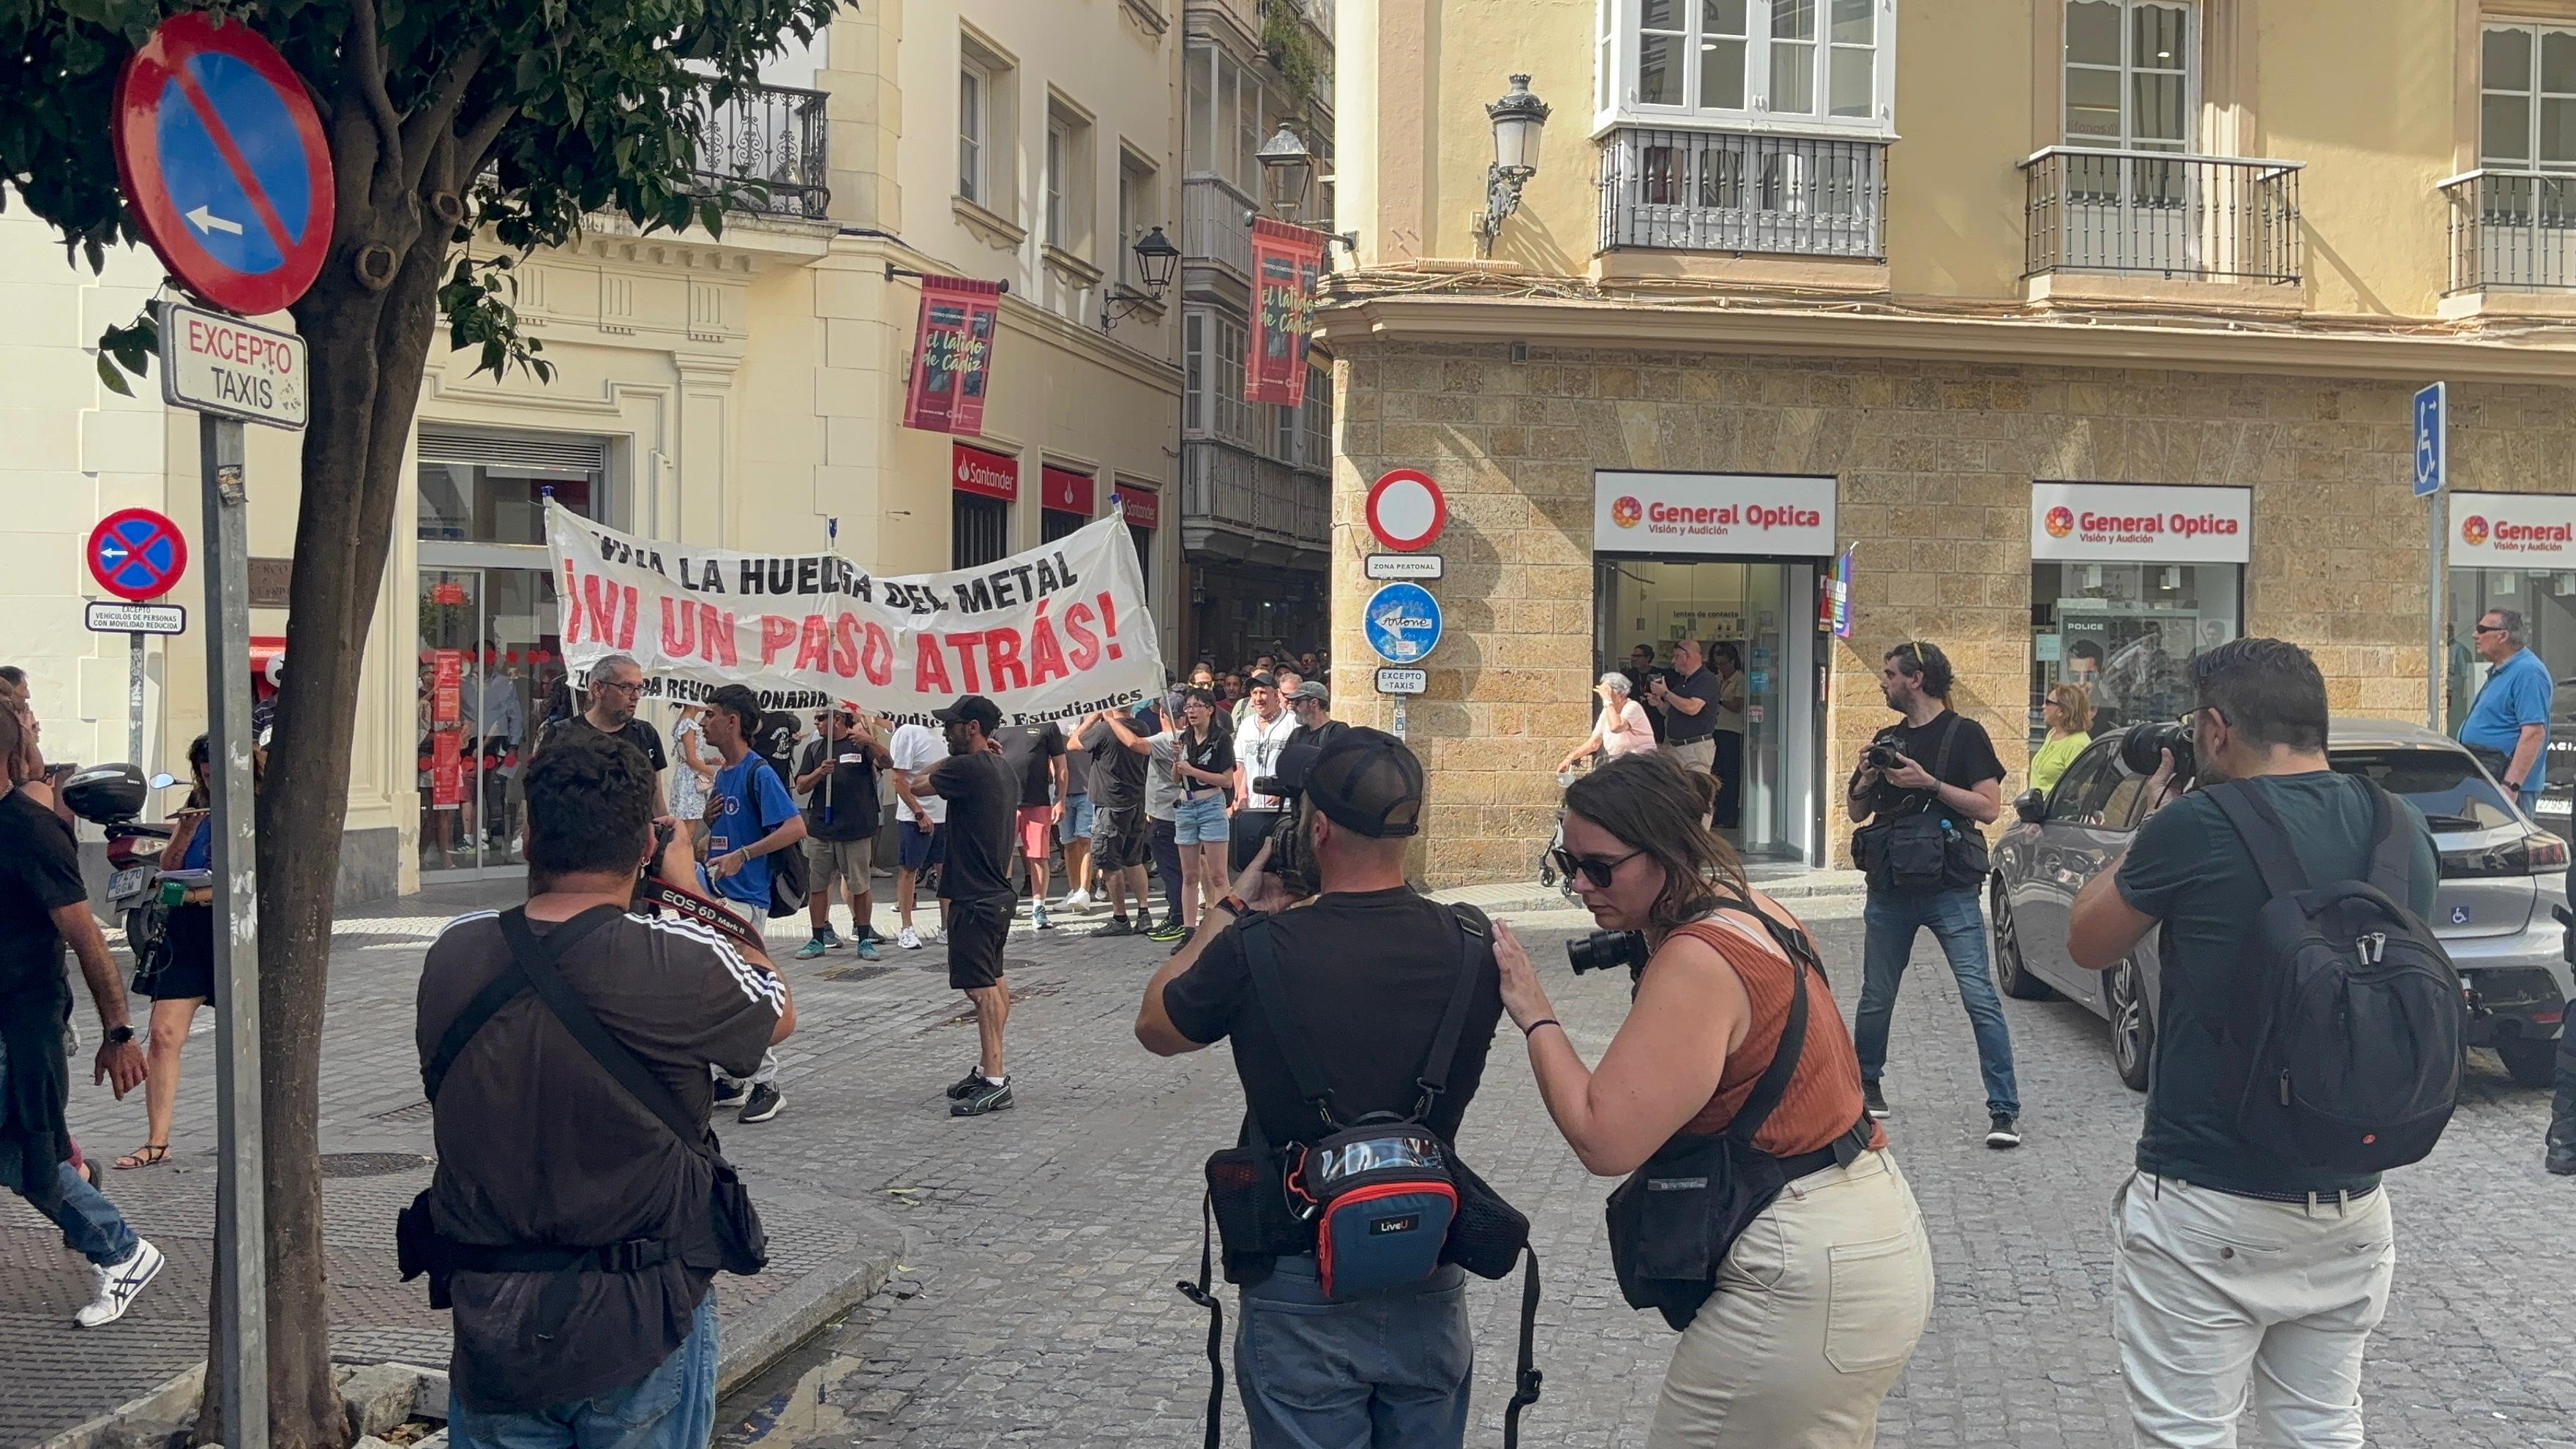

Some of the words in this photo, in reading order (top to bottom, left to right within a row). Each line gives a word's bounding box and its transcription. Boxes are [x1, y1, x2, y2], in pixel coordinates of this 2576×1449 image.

[1262, 285, 1274, 307] El
[1278, 284, 1316, 313] latido
[1259, 307, 1276, 327] de
[1279, 313, 1313, 337] Cádiz
[189, 320, 292, 374] EXCEPTO
[926, 330, 940, 348] El
[943, 329, 985, 356] latido
[921, 350, 940, 367] de
[942, 353, 983, 375] Cádiz
[211, 367, 272, 409] TAXIS
[970, 462, 1014, 492] Santander
[1126, 499, 1156, 521] Santander
[1649, 502, 1740, 525] General
[1745, 504, 1821, 531] Optica
[1649, 523, 1677, 533] Visión
[1680, 527, 1685, 536] y
[1688, 524, 1728, 536] Audición
[2079, 512, 2164, 533] General
[2170, 514, 2239, 539] Optica
[2080, 532, 2107, 542] Visión
[2108, 536, 2114, 544] y
[2116, 533, 2154, 544] Audición
[2493, 520, 2573, 542] General
[2493, 541, 2518, 550] Visión
[2520, 544, 2526, 553] y
[2527, 542, 2563, 552] Audición
[679, 557, 726, 594] LA
[739, 555, 872, 604] HUELGA
[883, 581, 949, 615] DEL
[954, 550, 1079, 614] METAL
[95, 612, 132, 621] VEHÍCULOS
[143, 614, 176, 622] PERSONAS
[109, 620, 144, 629] MOVILIDAD
[146, 621, 178, 629] REDUCIDA
[564, 558, 638, 651] ¡NI
[659, 595, 738, 667] UN
[760, 612, 894, 686] PASO
[914, 590, 1123, 694] ATRÁS!
[1673, 610, 1696, 618] lentes
[1697, 610, 1707, 618] de
[2067, 623, 2104, 631] POLICE
[1382, 672, 1422, 681] EXCEPTO
[1389, 682, 1415, 690] TAXIS
[1011, 688, 1143, 727] Estudiantes
[662, 889, 697, 911] EOS
[698, 906, 716, 921] 6D
[717, 916, 738, 931] Mark
[1381, 1219, 1409, 1232] LiveU
